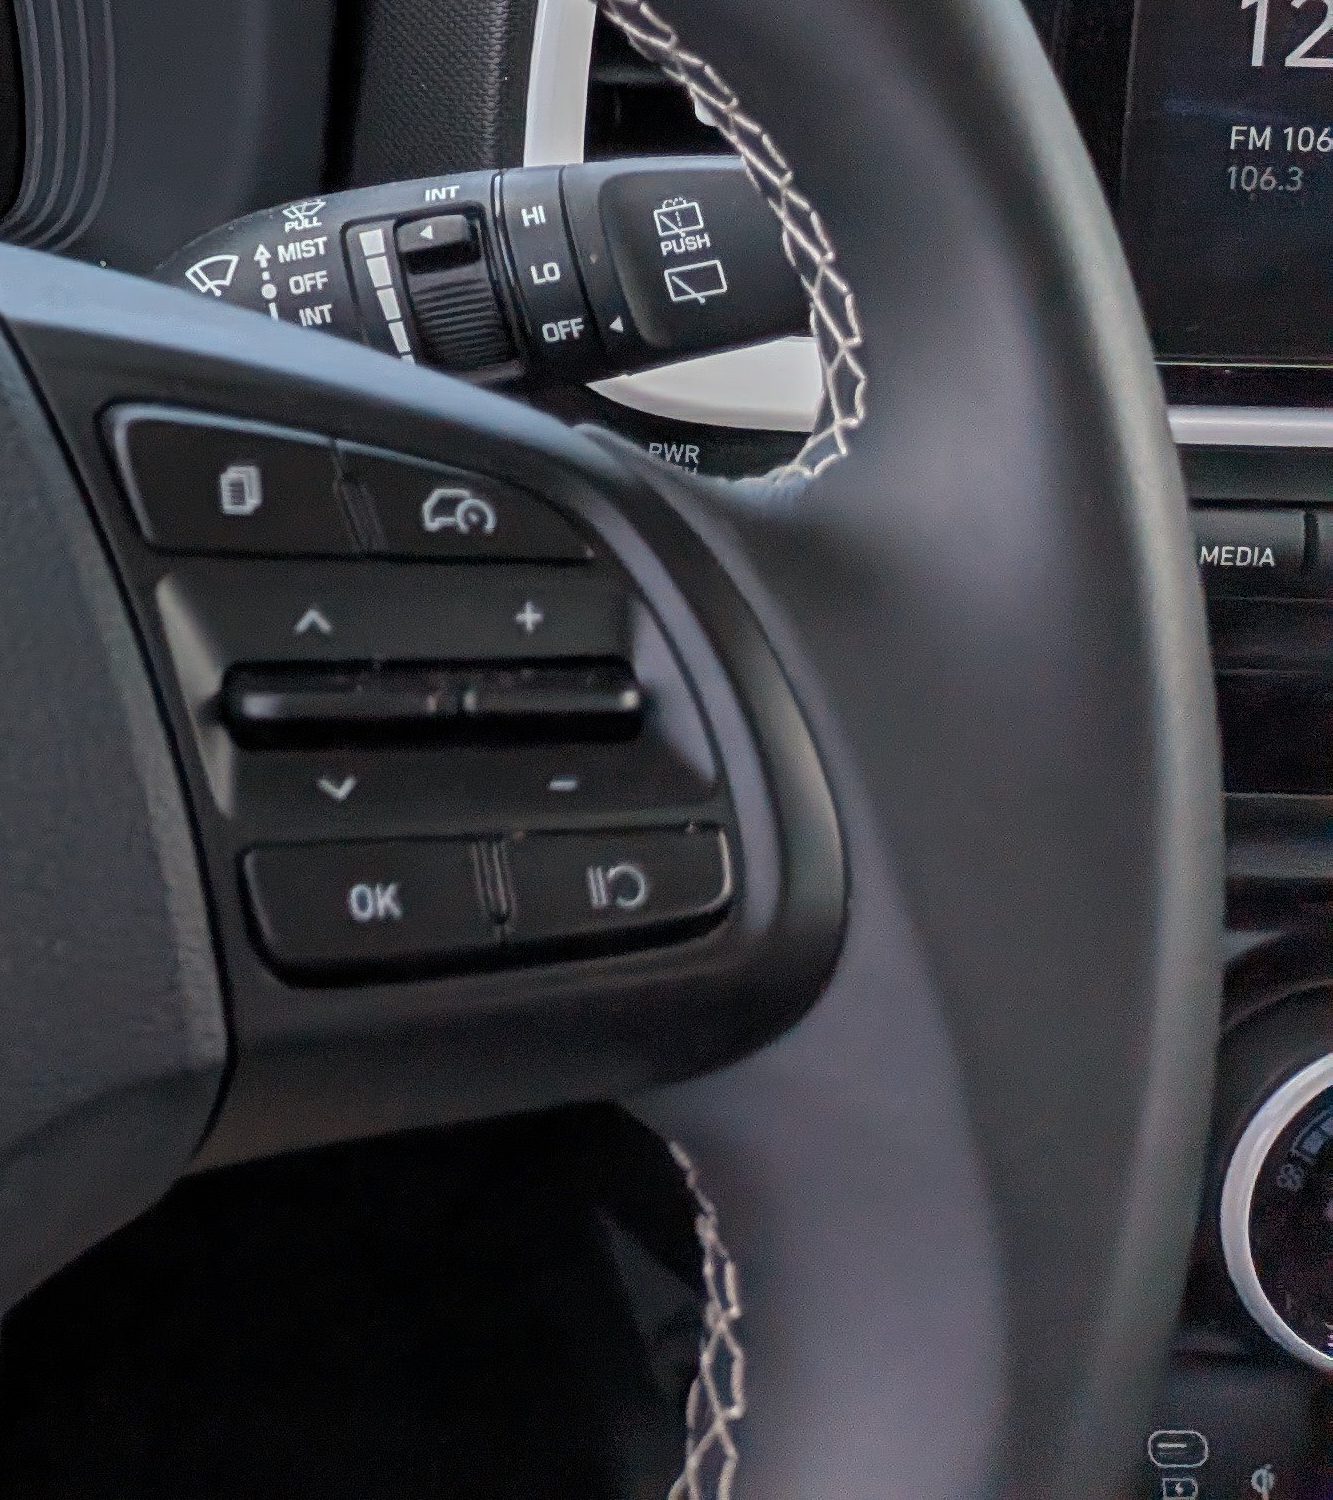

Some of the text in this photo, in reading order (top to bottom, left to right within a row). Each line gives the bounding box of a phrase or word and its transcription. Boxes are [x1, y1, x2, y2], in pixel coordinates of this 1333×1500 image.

[1230, 125, 1272, 151] FM
[1227, 164, 1303, 192] 106.3
[424, 185, 460, 202] INT
[284, 216, 322, 234] PULL
[522, 205, 546, 227] HI
[277, 236, 328, 264] MIST
[660, 233, 712, 256] PUSH
[289, 270, 329, 295] OFF
[531, 262, 561, 284] LO
[298, 303, 333, 327] INT
[541, 318, 585, 343] OFF
[648, 441, 700, 464] PWR
[1199, 546, 1276, 567] MEDIA
[349, 883, 403, 919] OK
